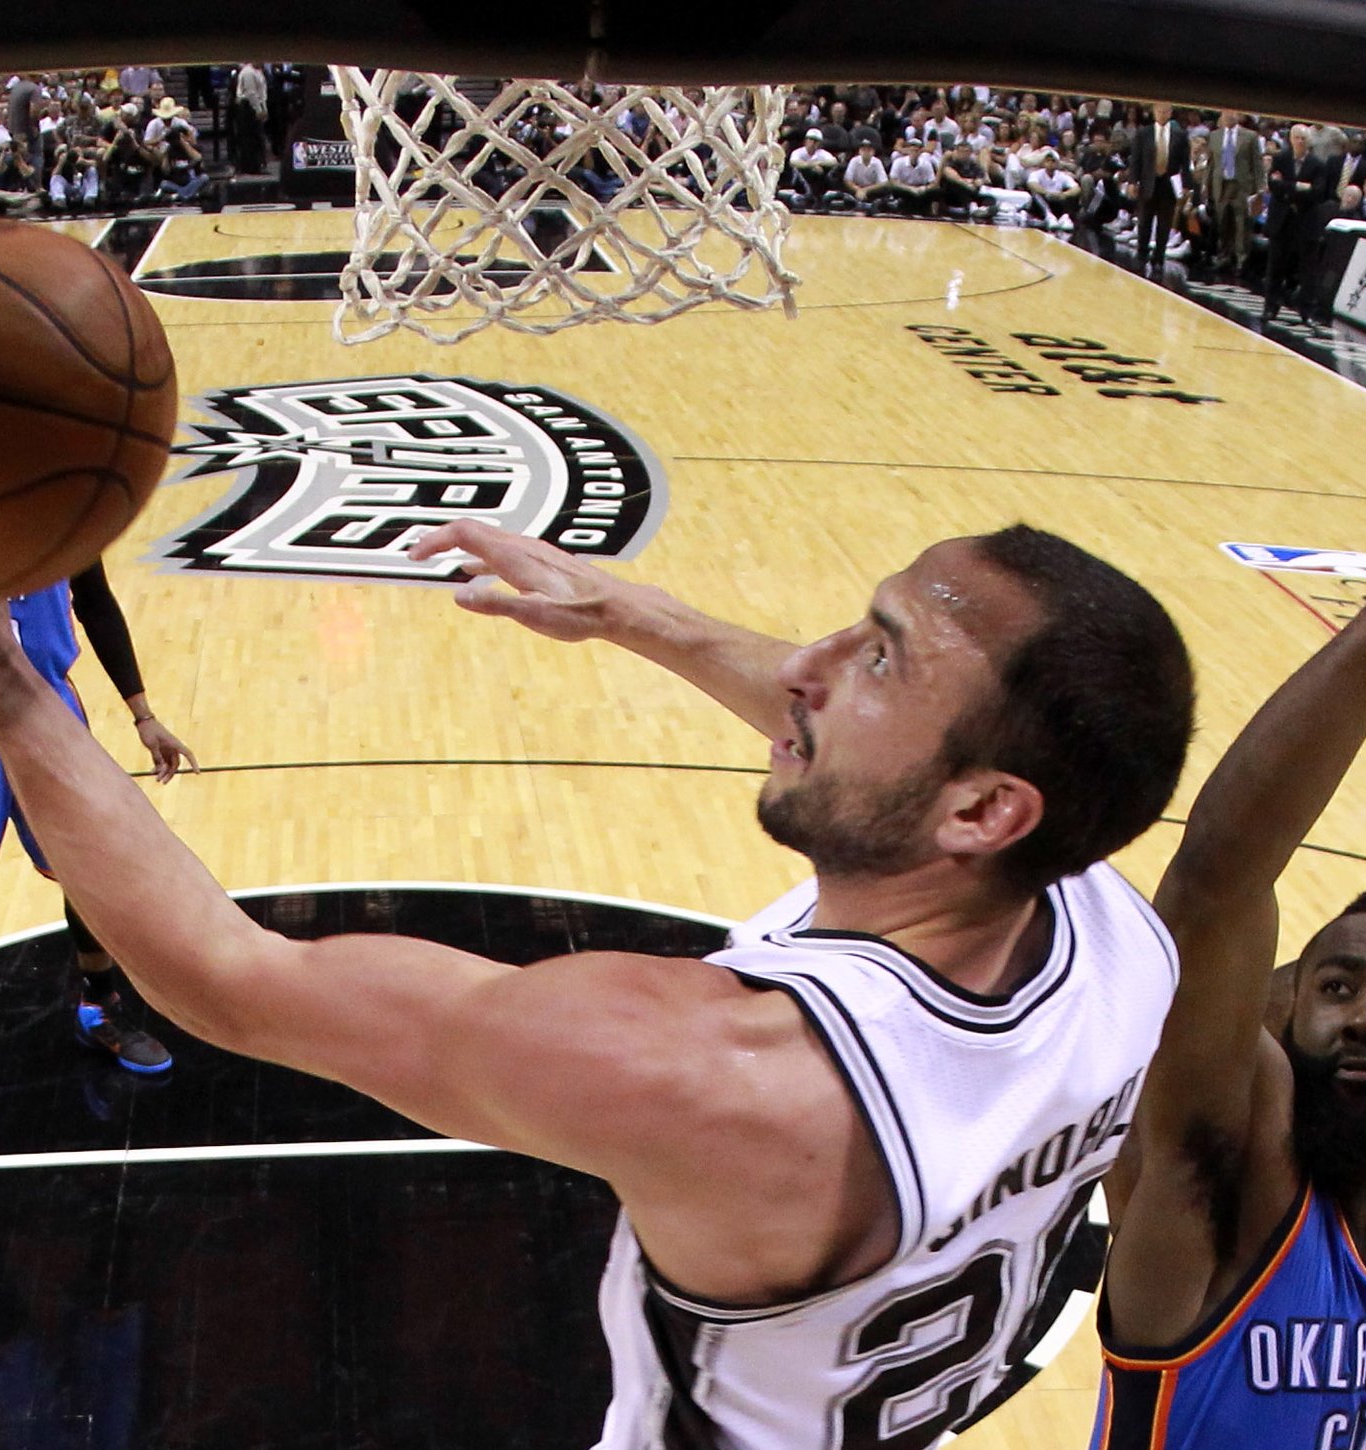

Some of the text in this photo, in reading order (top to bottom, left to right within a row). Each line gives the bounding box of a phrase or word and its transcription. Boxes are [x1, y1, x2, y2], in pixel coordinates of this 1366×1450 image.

[904, 324, 1062, 396] CENTER
[503, 392, 626, 547] SAN ANTONIO
